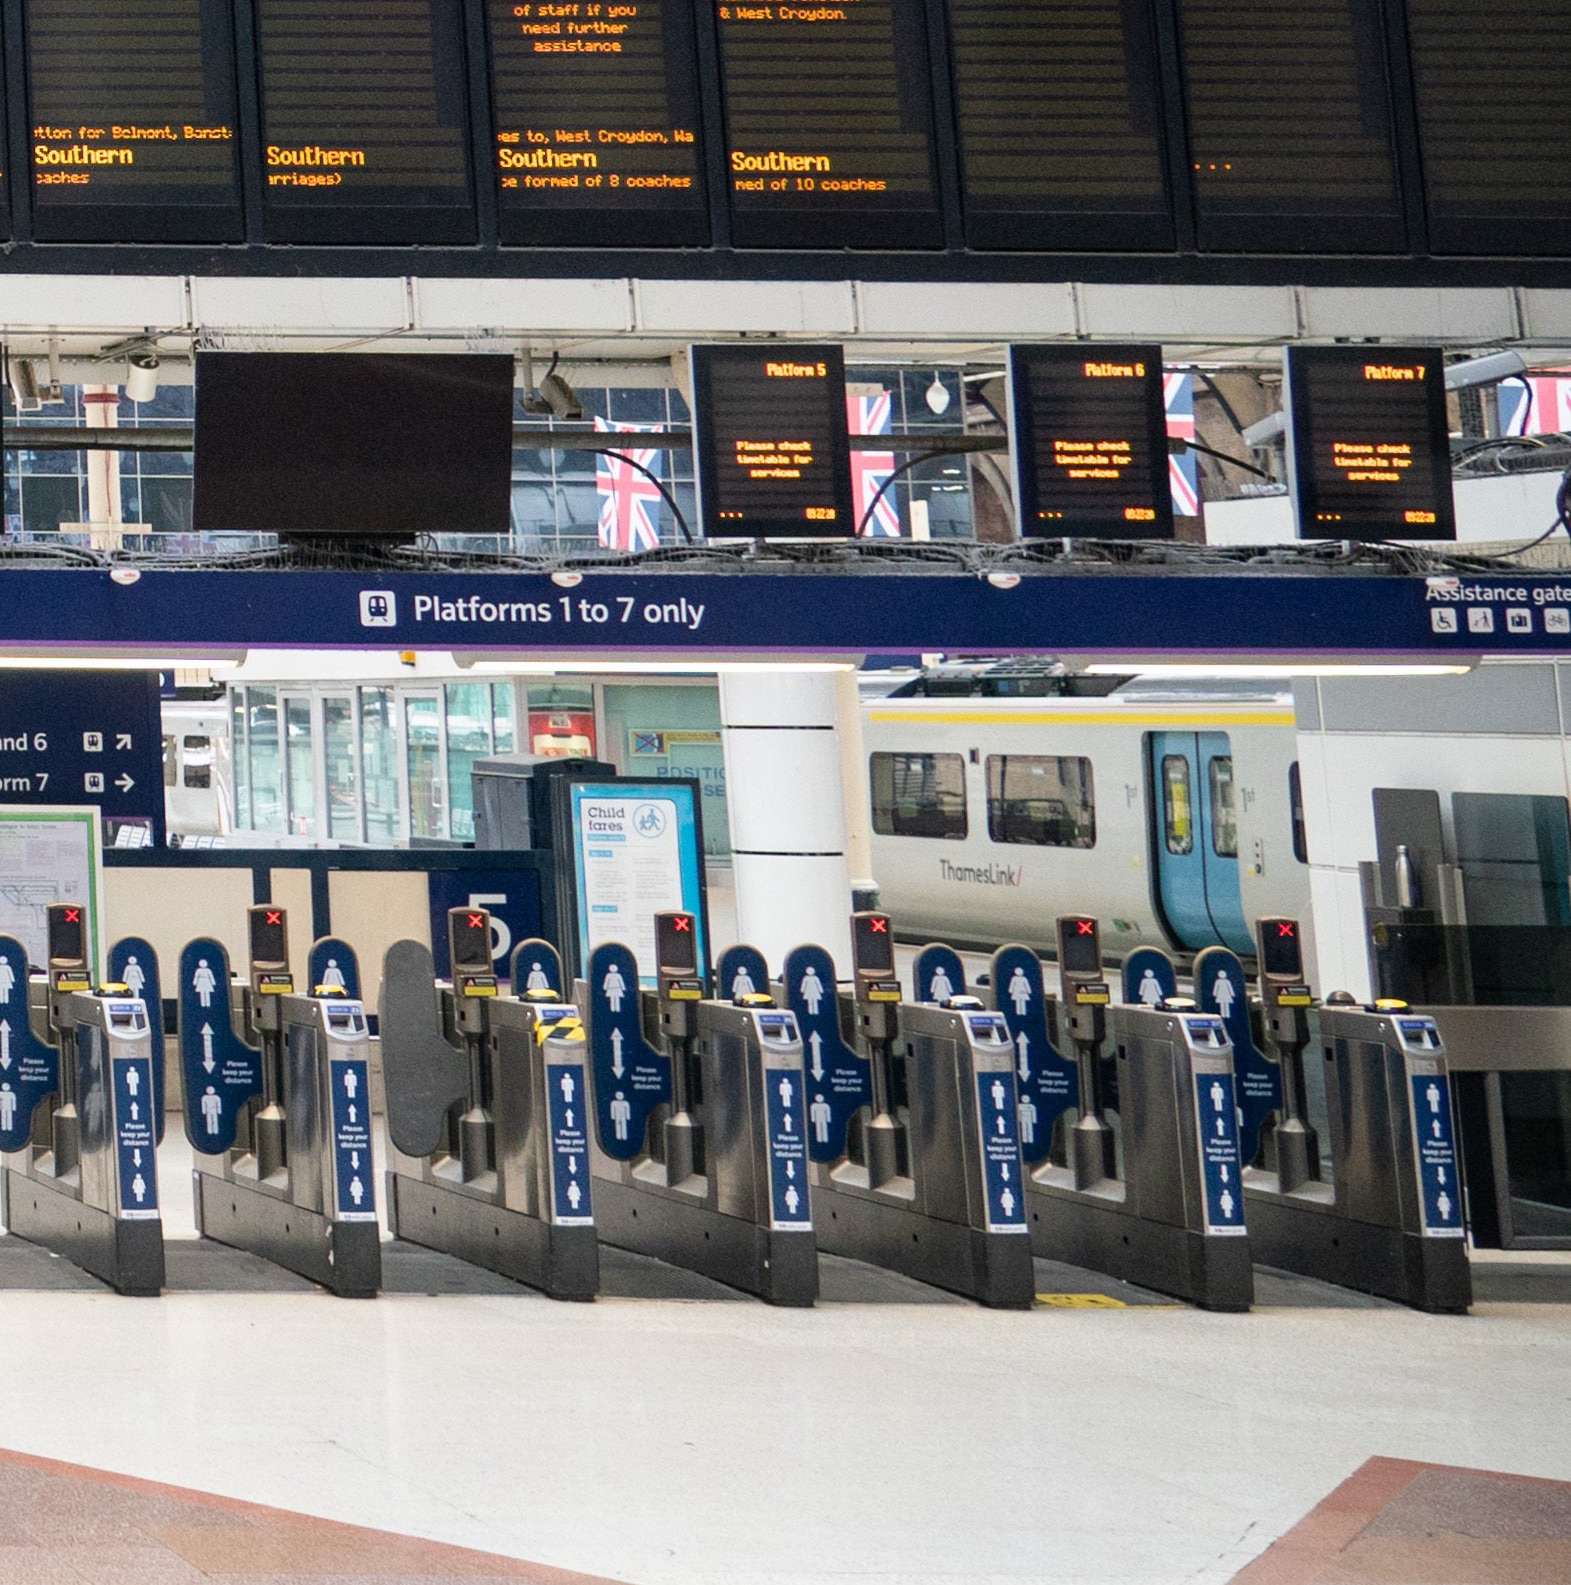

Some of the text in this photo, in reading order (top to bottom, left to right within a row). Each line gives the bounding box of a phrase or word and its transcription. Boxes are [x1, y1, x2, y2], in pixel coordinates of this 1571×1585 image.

[730, 151, 831, 172] Southern
[1365, 365, 1426, 380] Platform 7
[415, 596, 704, 629] Platforms 1 to 7 only
[36, 774, 48, 790] 7
[587, 806, 626, 818] Child
[588, 821, 624, 831] fares
